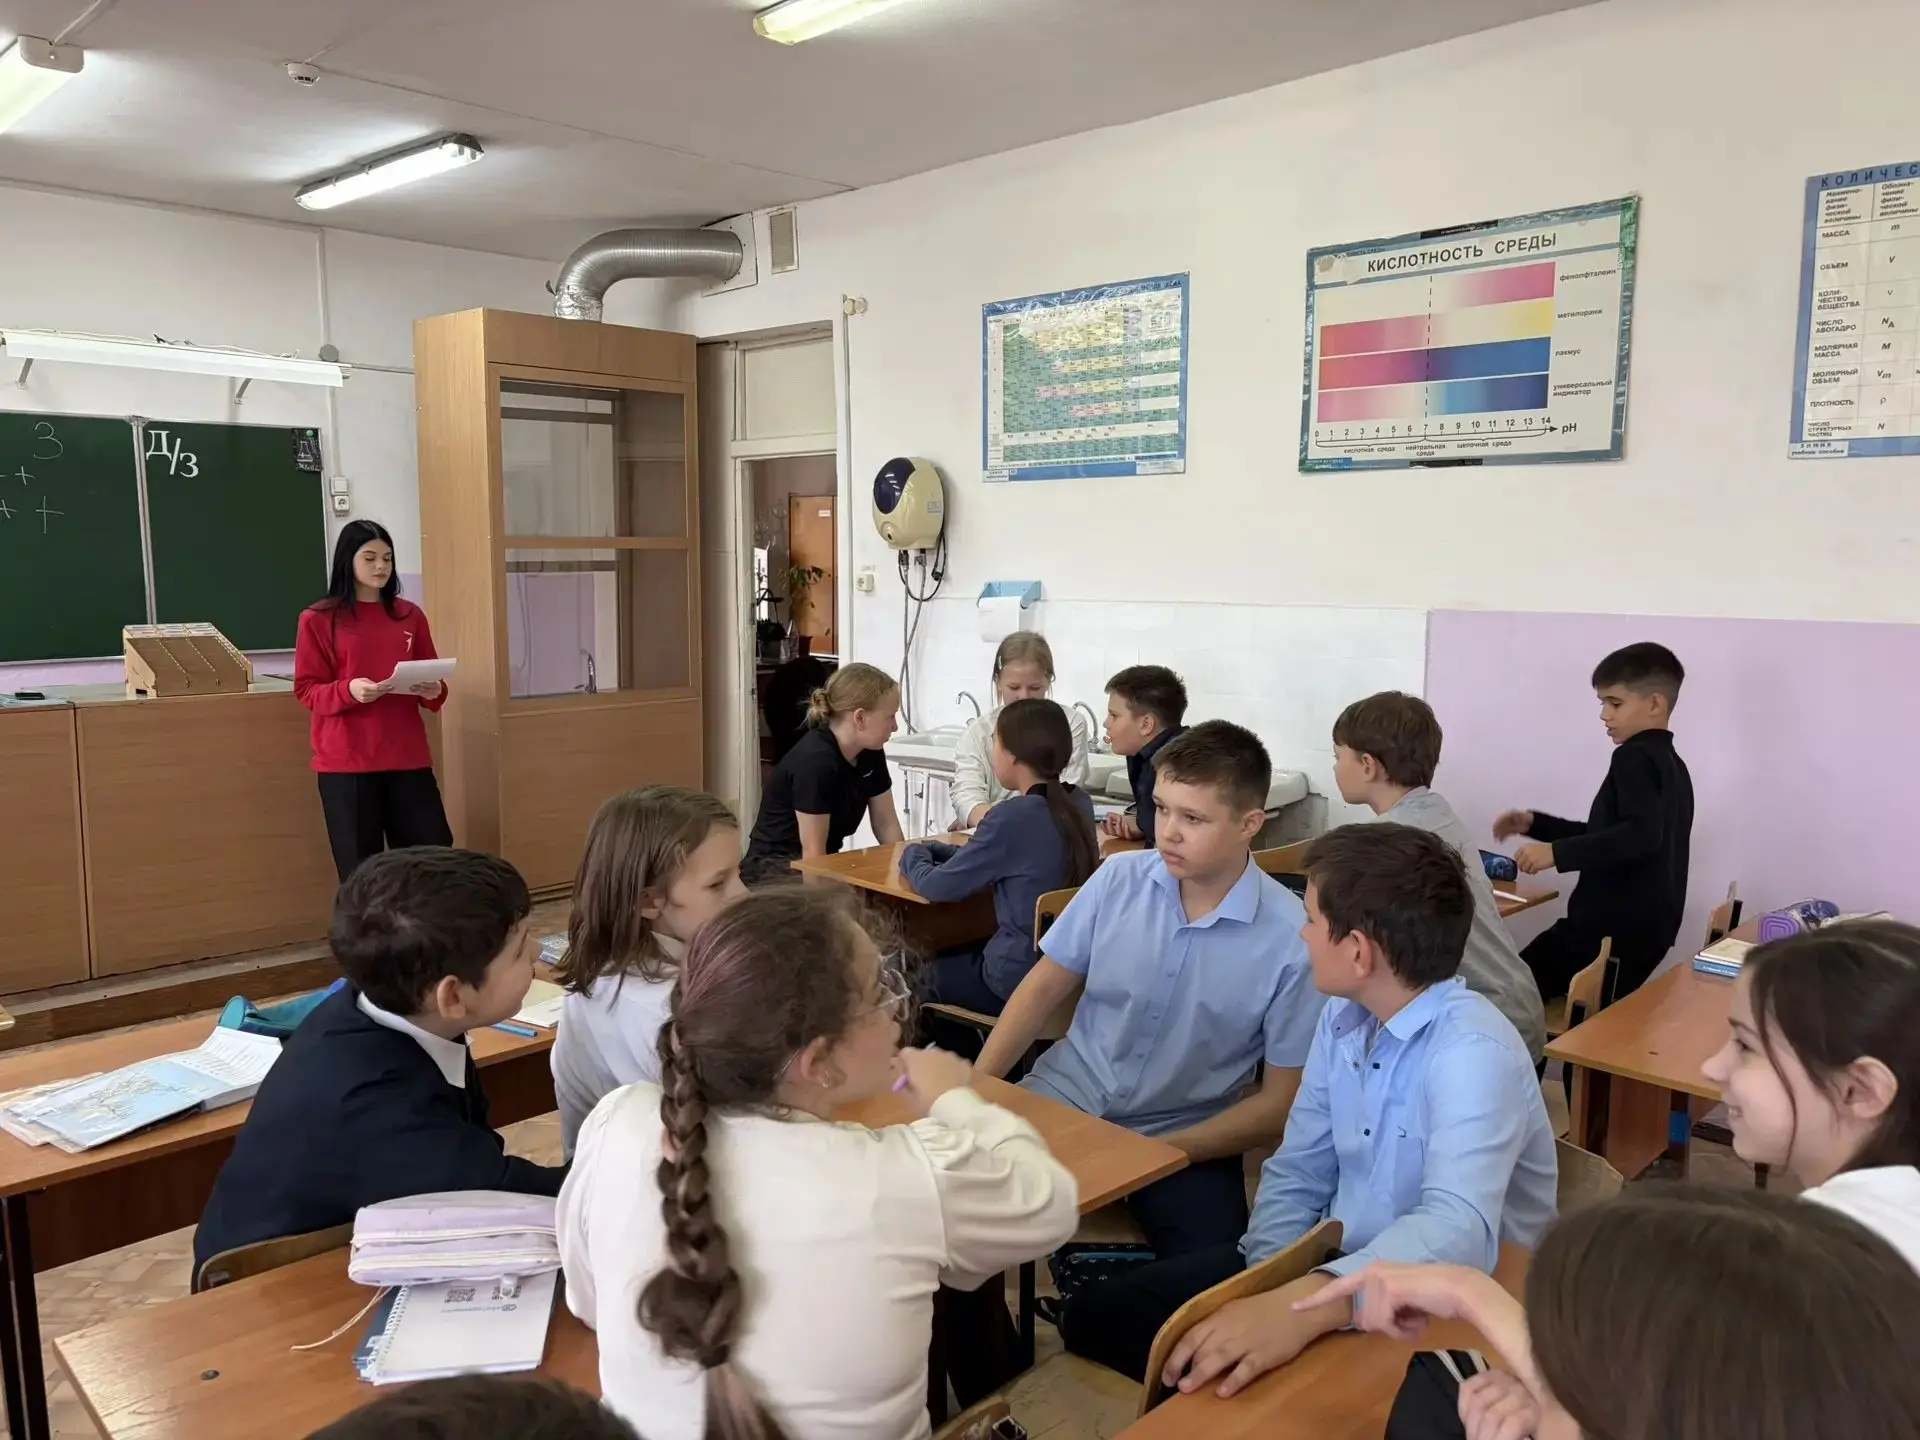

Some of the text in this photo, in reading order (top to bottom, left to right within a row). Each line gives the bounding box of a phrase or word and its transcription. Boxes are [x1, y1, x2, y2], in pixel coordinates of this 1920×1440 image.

[1822, 230, 1850, 238] МАССА
[1367, 244, 1484, 272] КИСЛОТНОСТЬ
[1494, 232, 1557, 255] СРЕДЫ
[1820, 261, 1849, 270] ОБЪЕМ
[1818, 289, 1842, 297] КОЛИ-
[1817, 295, 1848, 303] ЧЕСТВО
[1817, 301, 1860, 310] ВЕЩЕСТВА
[1557, 308, 1603, 319] метилоранж
[1816, 318, 1843, 326] ЧИСЛО
[1815, 324, 1857, 333] АВОГАДРО
[1814, 342, 1858, 351] МОЛЯРНАЯ
[1555, 348, 1581, 357] лакмус
[1814, 350, 1841, 358] МАССА
[1812, 368, 1858, 377] МОЛЯРНЫЙ
[1812, 376, 1840, 384] ОБЪЕМ
[1552, 379, 1612, 391] универсальный
[1552, 388, 1591, 398] индикатор
[1809, 399, 1854, 407] ПЛОТНОСТЬ
[1314, 430, 1319, 438] 0
[1344, 428, 1349, 436] 2
[1360, 427, 1365, 435] 3
[1375, 426, 1380, 434] 4
[1391, 425, 1396, 433] 5
[1471, 421, 1480, 429] 10
[1506, 418, 1515, 426] 12
[1523, 417, 1533, 425] 13
[1541, 416, 1551, 424] 14
[1561, 422, 1577, 434] pH
[1808, 425, 1852, 433] СТРУКТУРНЫХ
[1405, 443, 1446, 451] нейтральная
[1457, 440, 1512, 449] щелочная среда
[1344, 445, 1395, 454] кислотная среда
[1416, 449, 1435, 457] среда
